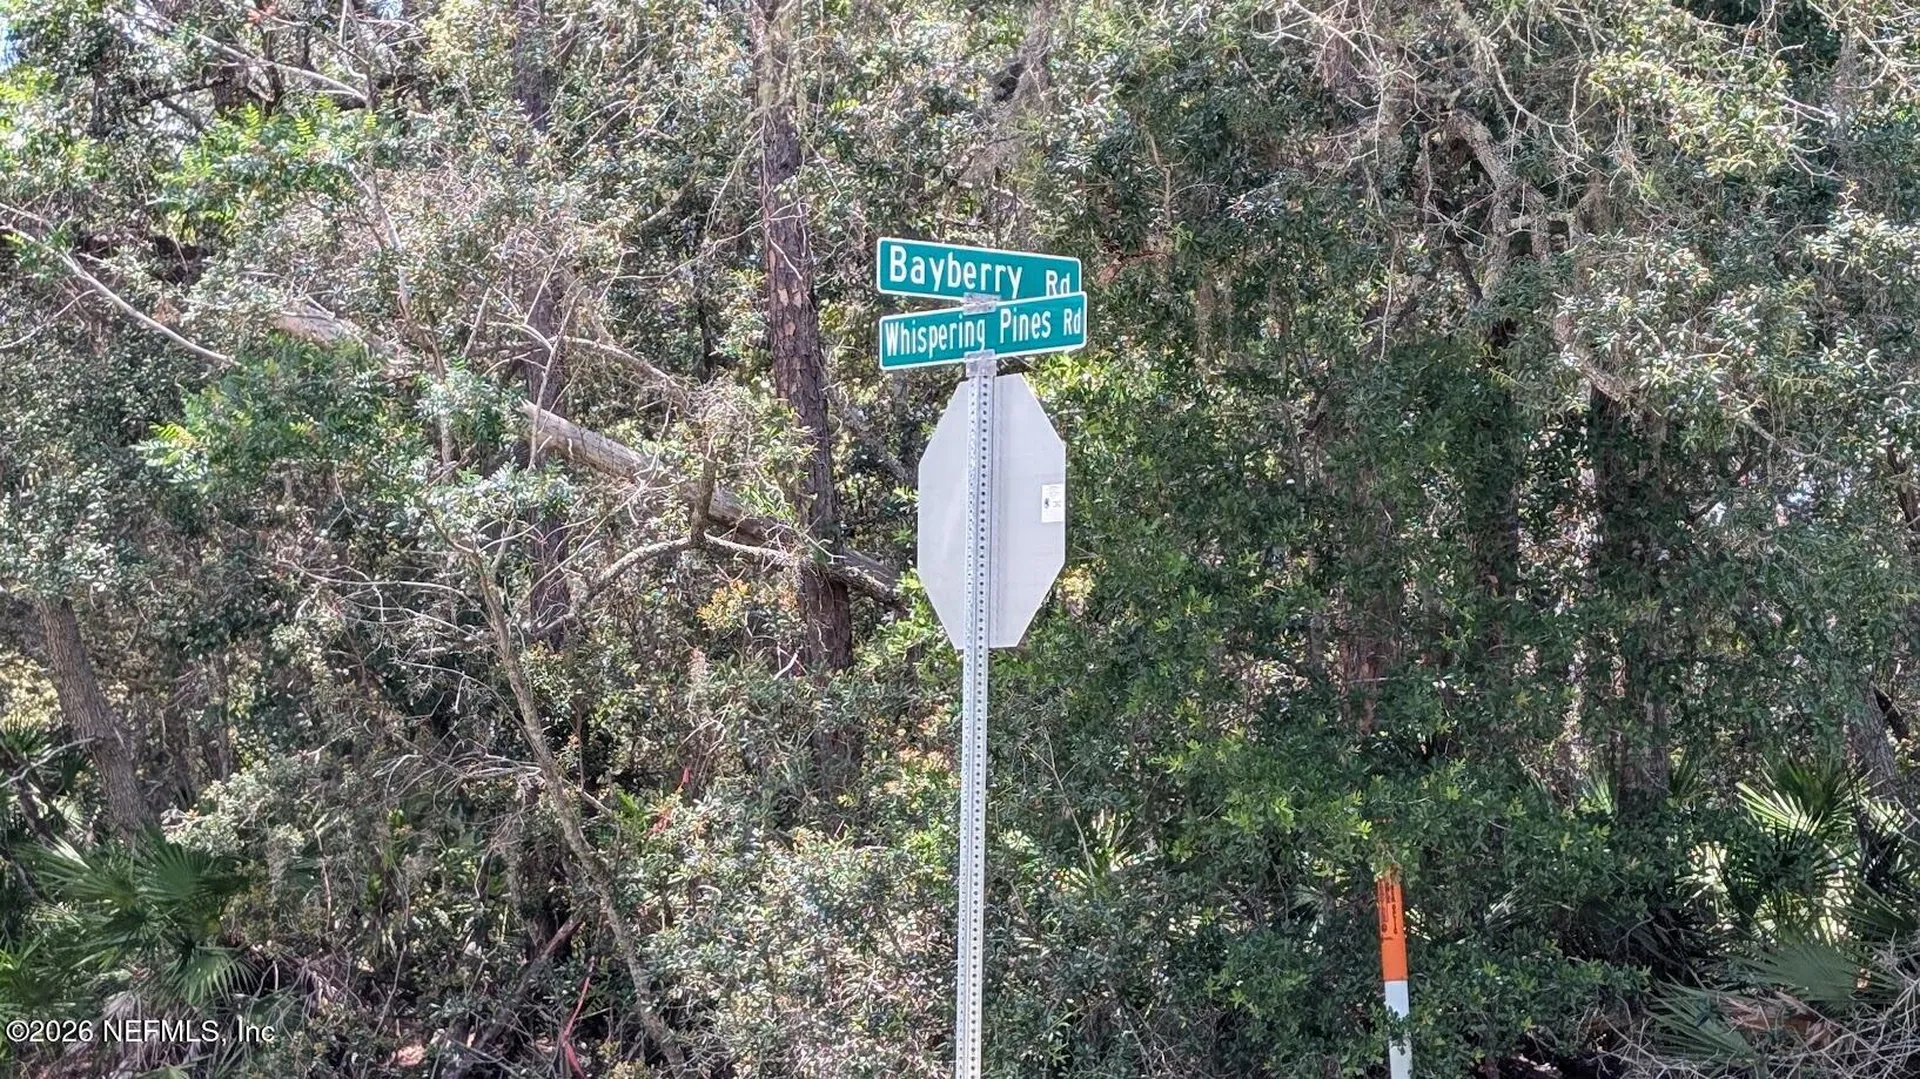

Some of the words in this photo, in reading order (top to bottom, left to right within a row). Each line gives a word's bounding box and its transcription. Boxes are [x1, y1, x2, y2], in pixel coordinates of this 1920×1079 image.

[889, 245, 1023, 299] Bayberry
[1045, 269, 1071, 296] Rd
[885, 313, 985, 359] Whispering
[1000, 307, 1052, 344] Pines
[1063, 307, 1081, 336] Rd
